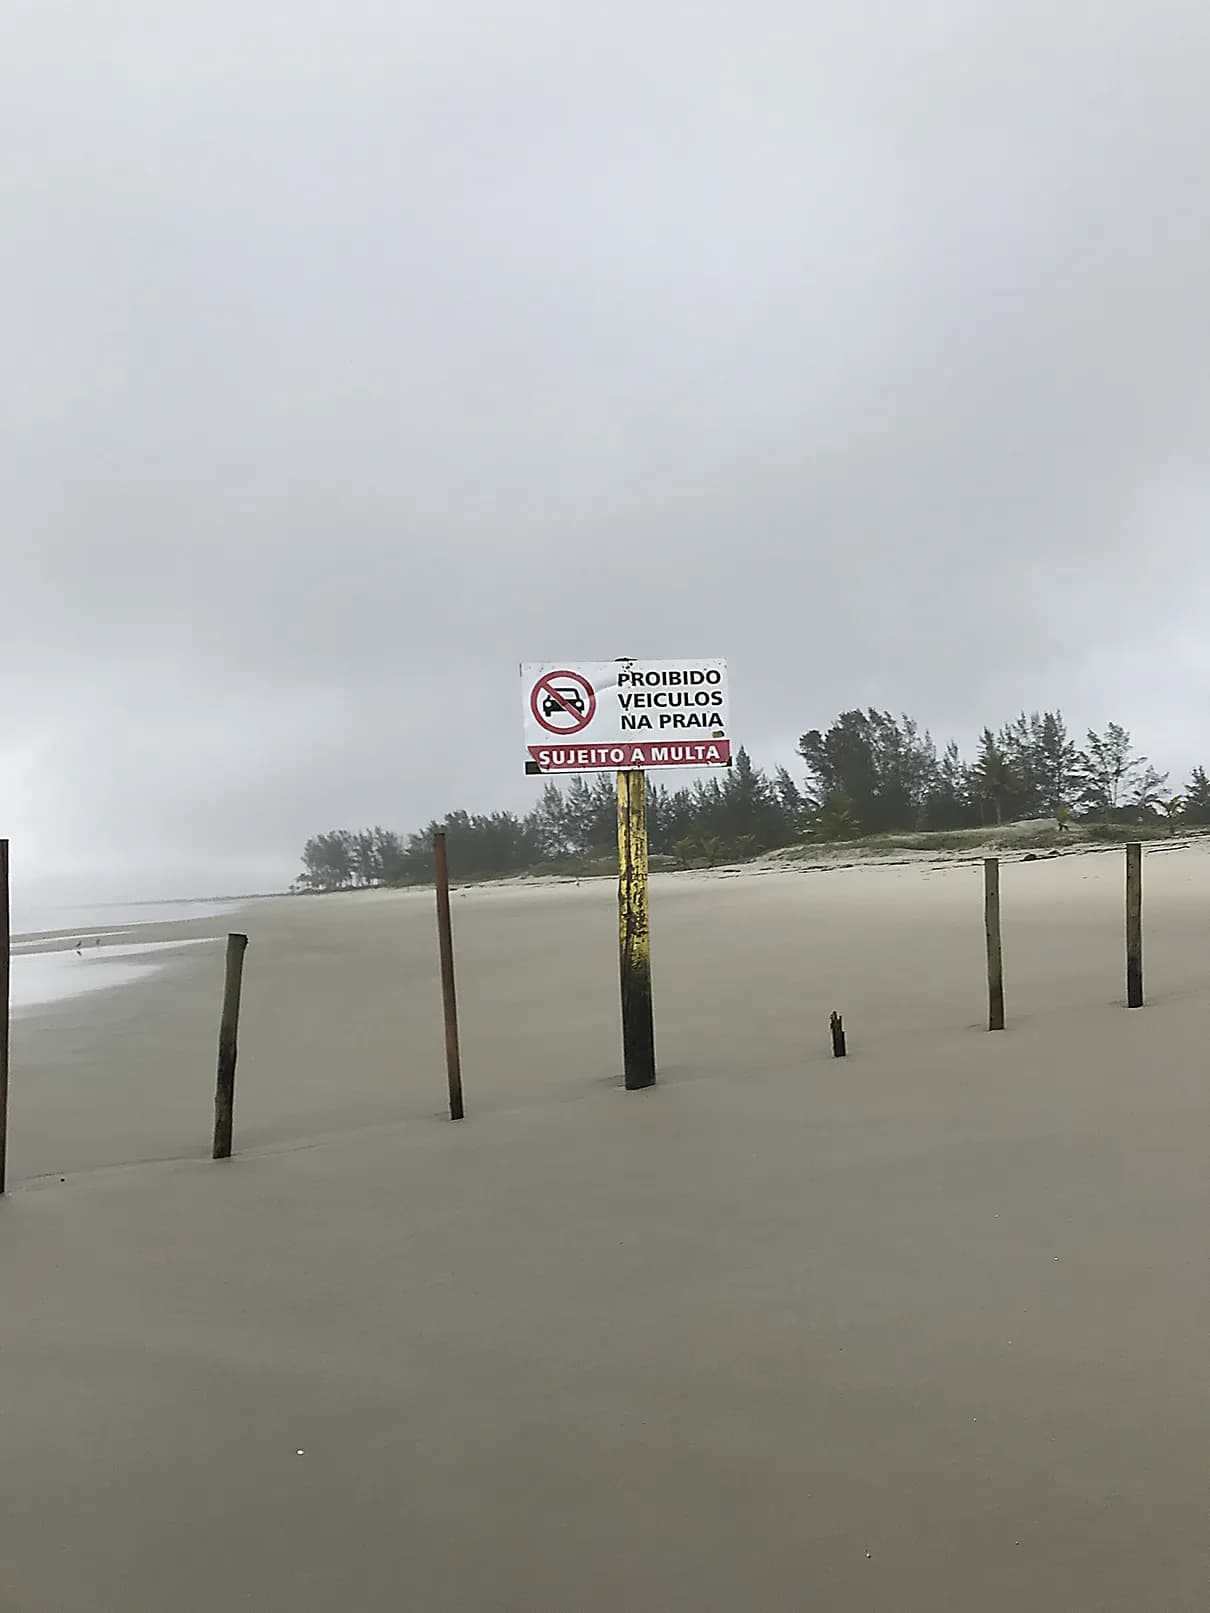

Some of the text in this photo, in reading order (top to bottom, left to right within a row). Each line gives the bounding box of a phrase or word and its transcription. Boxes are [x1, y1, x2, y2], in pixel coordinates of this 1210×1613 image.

[617, 670, 721, 687] PROIBIDO
[617, 691, 723, 708] VEICULOS
[621, 713, 724, 730] NA PRAIA
[539, 745, 720, 765] SUJEITO A MULTA
